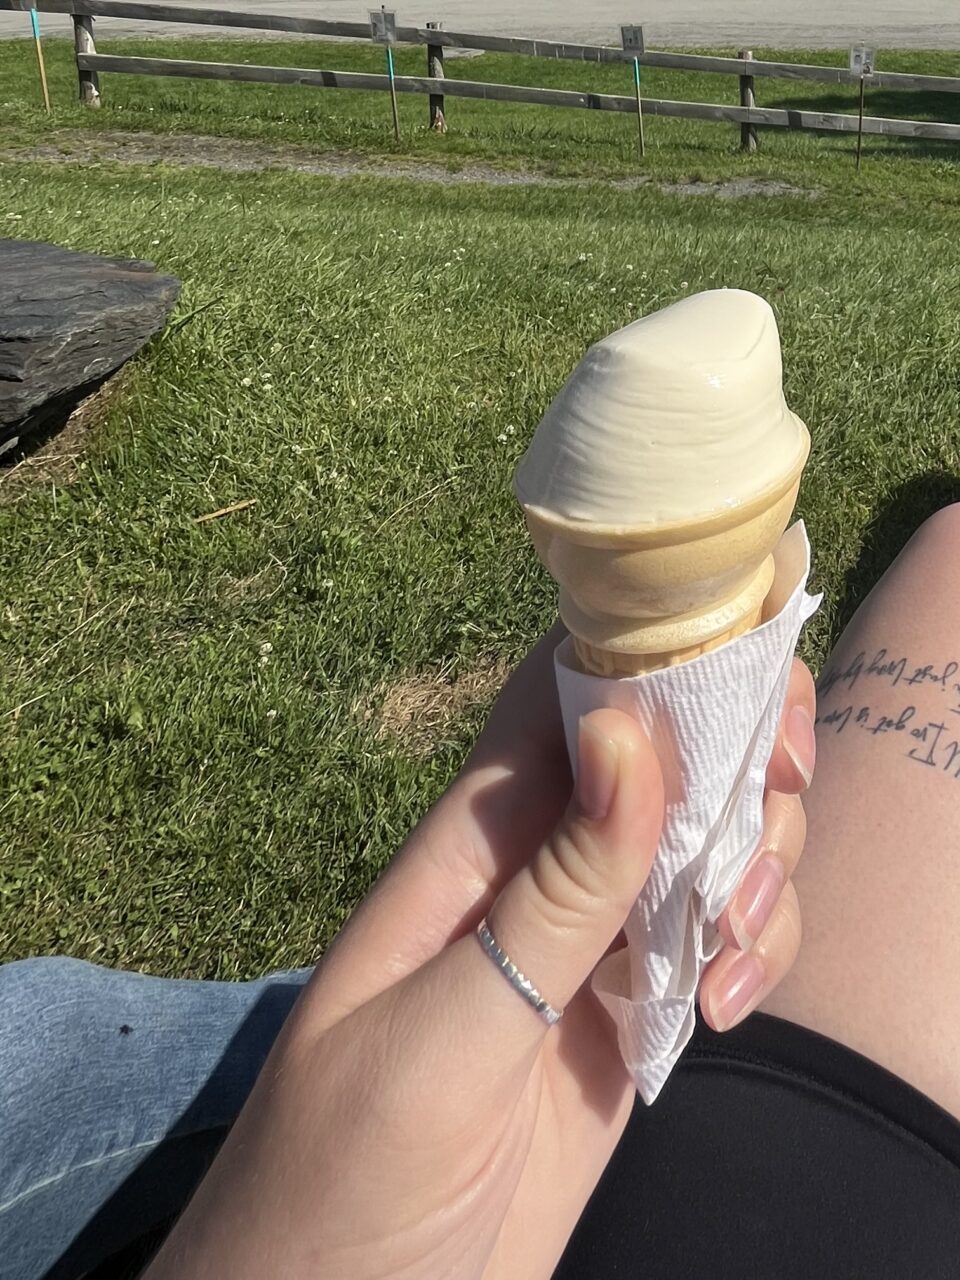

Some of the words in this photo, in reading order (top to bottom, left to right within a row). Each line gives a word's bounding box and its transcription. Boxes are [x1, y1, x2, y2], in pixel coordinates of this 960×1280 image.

[904, 661, 959, 693] just
[856, 706, 870, 729] is
[866, 705, 915, 735] got
[904, 722, 949, 767] I've
